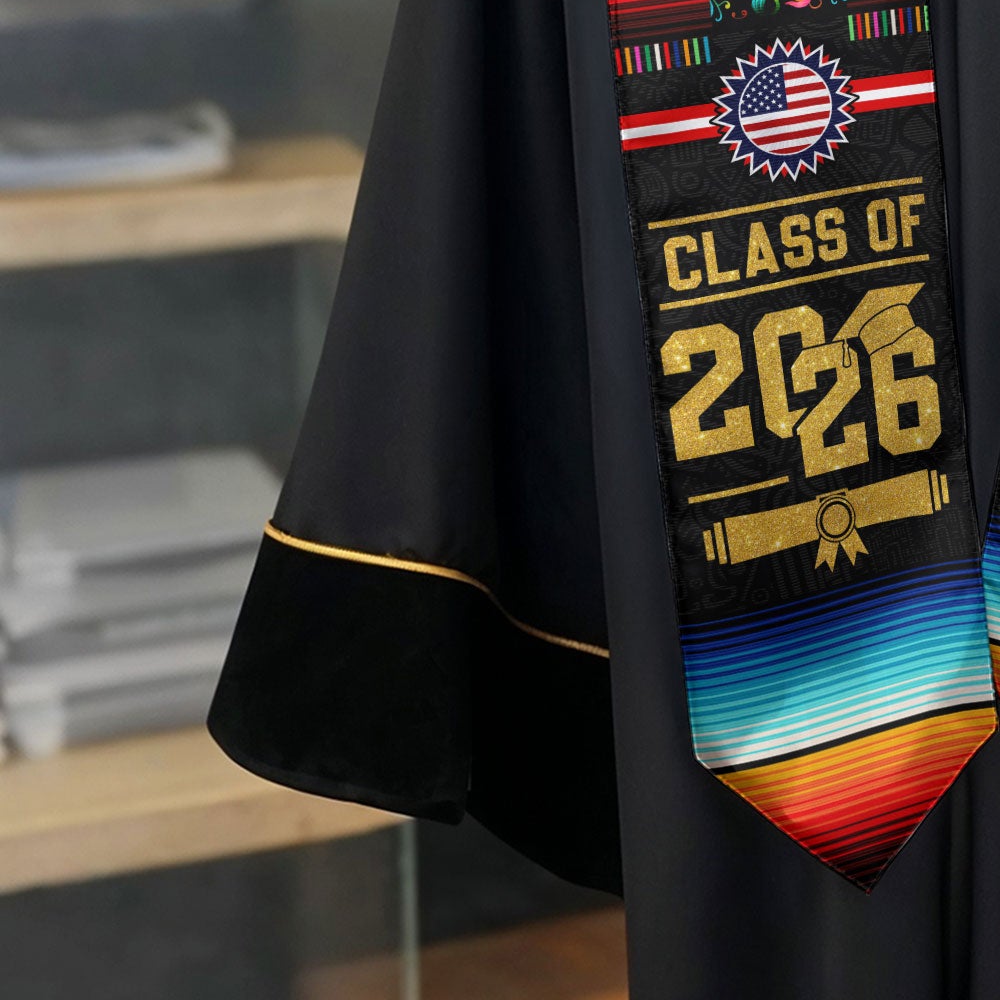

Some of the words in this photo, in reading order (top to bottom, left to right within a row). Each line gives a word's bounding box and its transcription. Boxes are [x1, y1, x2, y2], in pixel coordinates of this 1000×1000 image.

[663, 206, 848, 291] CLASS
[867, 194, 926, 252] OF
[660, 305, 942, 478] 2026
